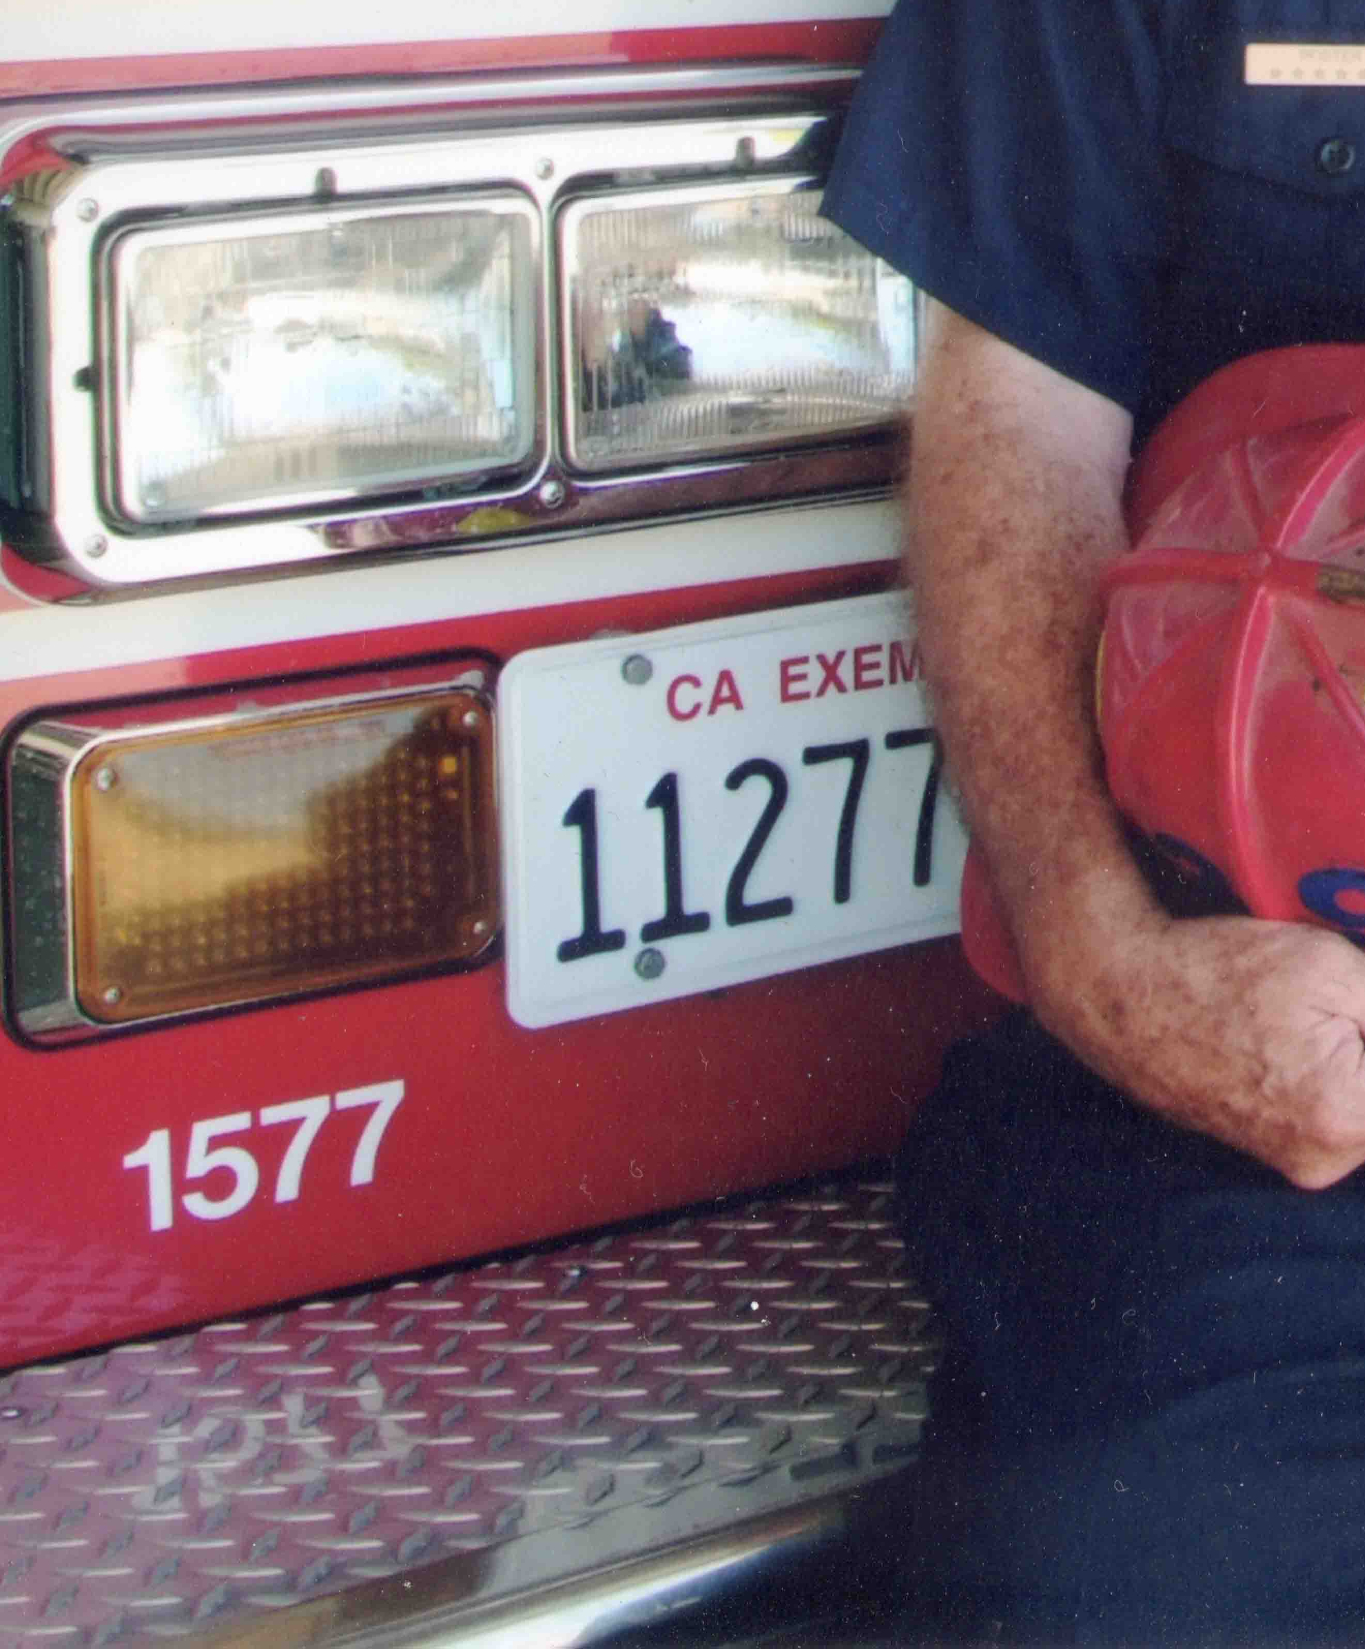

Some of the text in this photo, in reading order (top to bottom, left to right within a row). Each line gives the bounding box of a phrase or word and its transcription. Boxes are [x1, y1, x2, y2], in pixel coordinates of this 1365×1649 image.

[665, 669, 745, 721] CA
[556, 727, 943, 963] 11277
[122, 1078, 405, 1233] 1577
